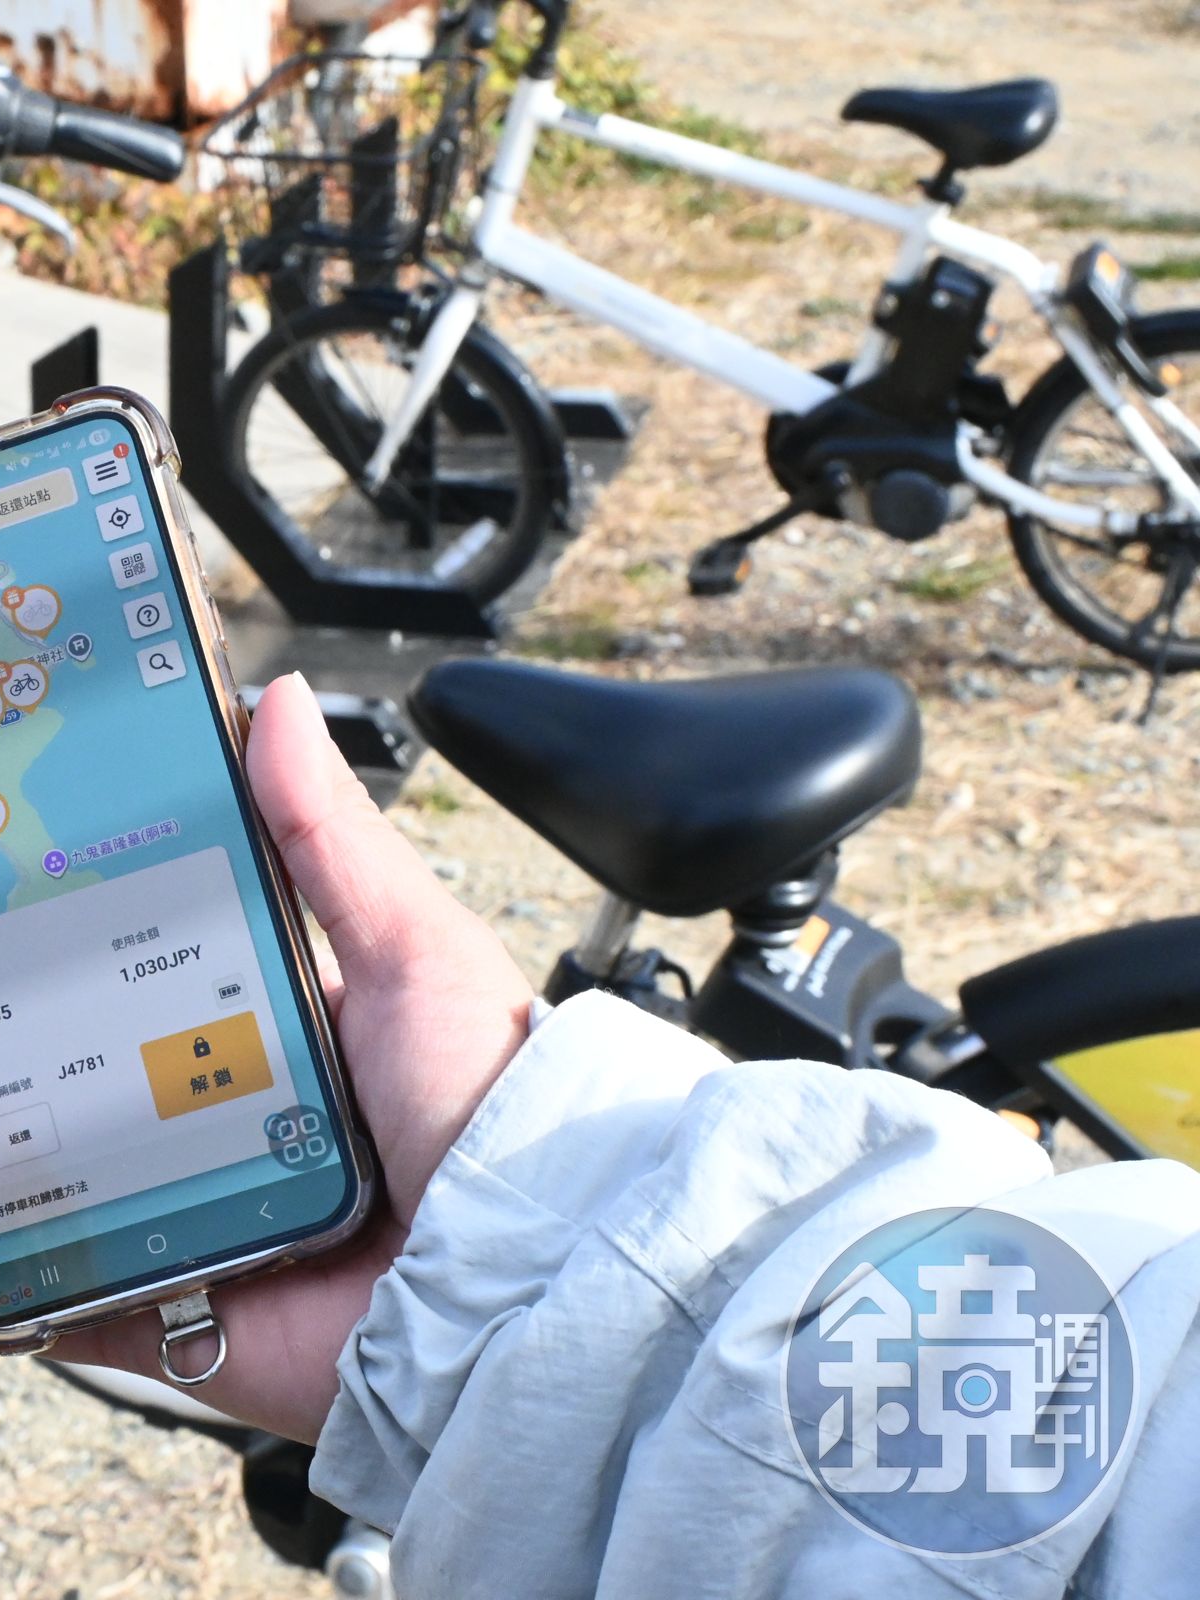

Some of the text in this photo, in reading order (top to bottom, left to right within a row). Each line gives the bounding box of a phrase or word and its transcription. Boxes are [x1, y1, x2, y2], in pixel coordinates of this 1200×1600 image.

[29, 648, 65, 665] 神社
[111, 926, 161, 951] 使用金額
[119, 944, 202, 983] 1,030JPY
[58, 1054, 105, 1080] J4781
